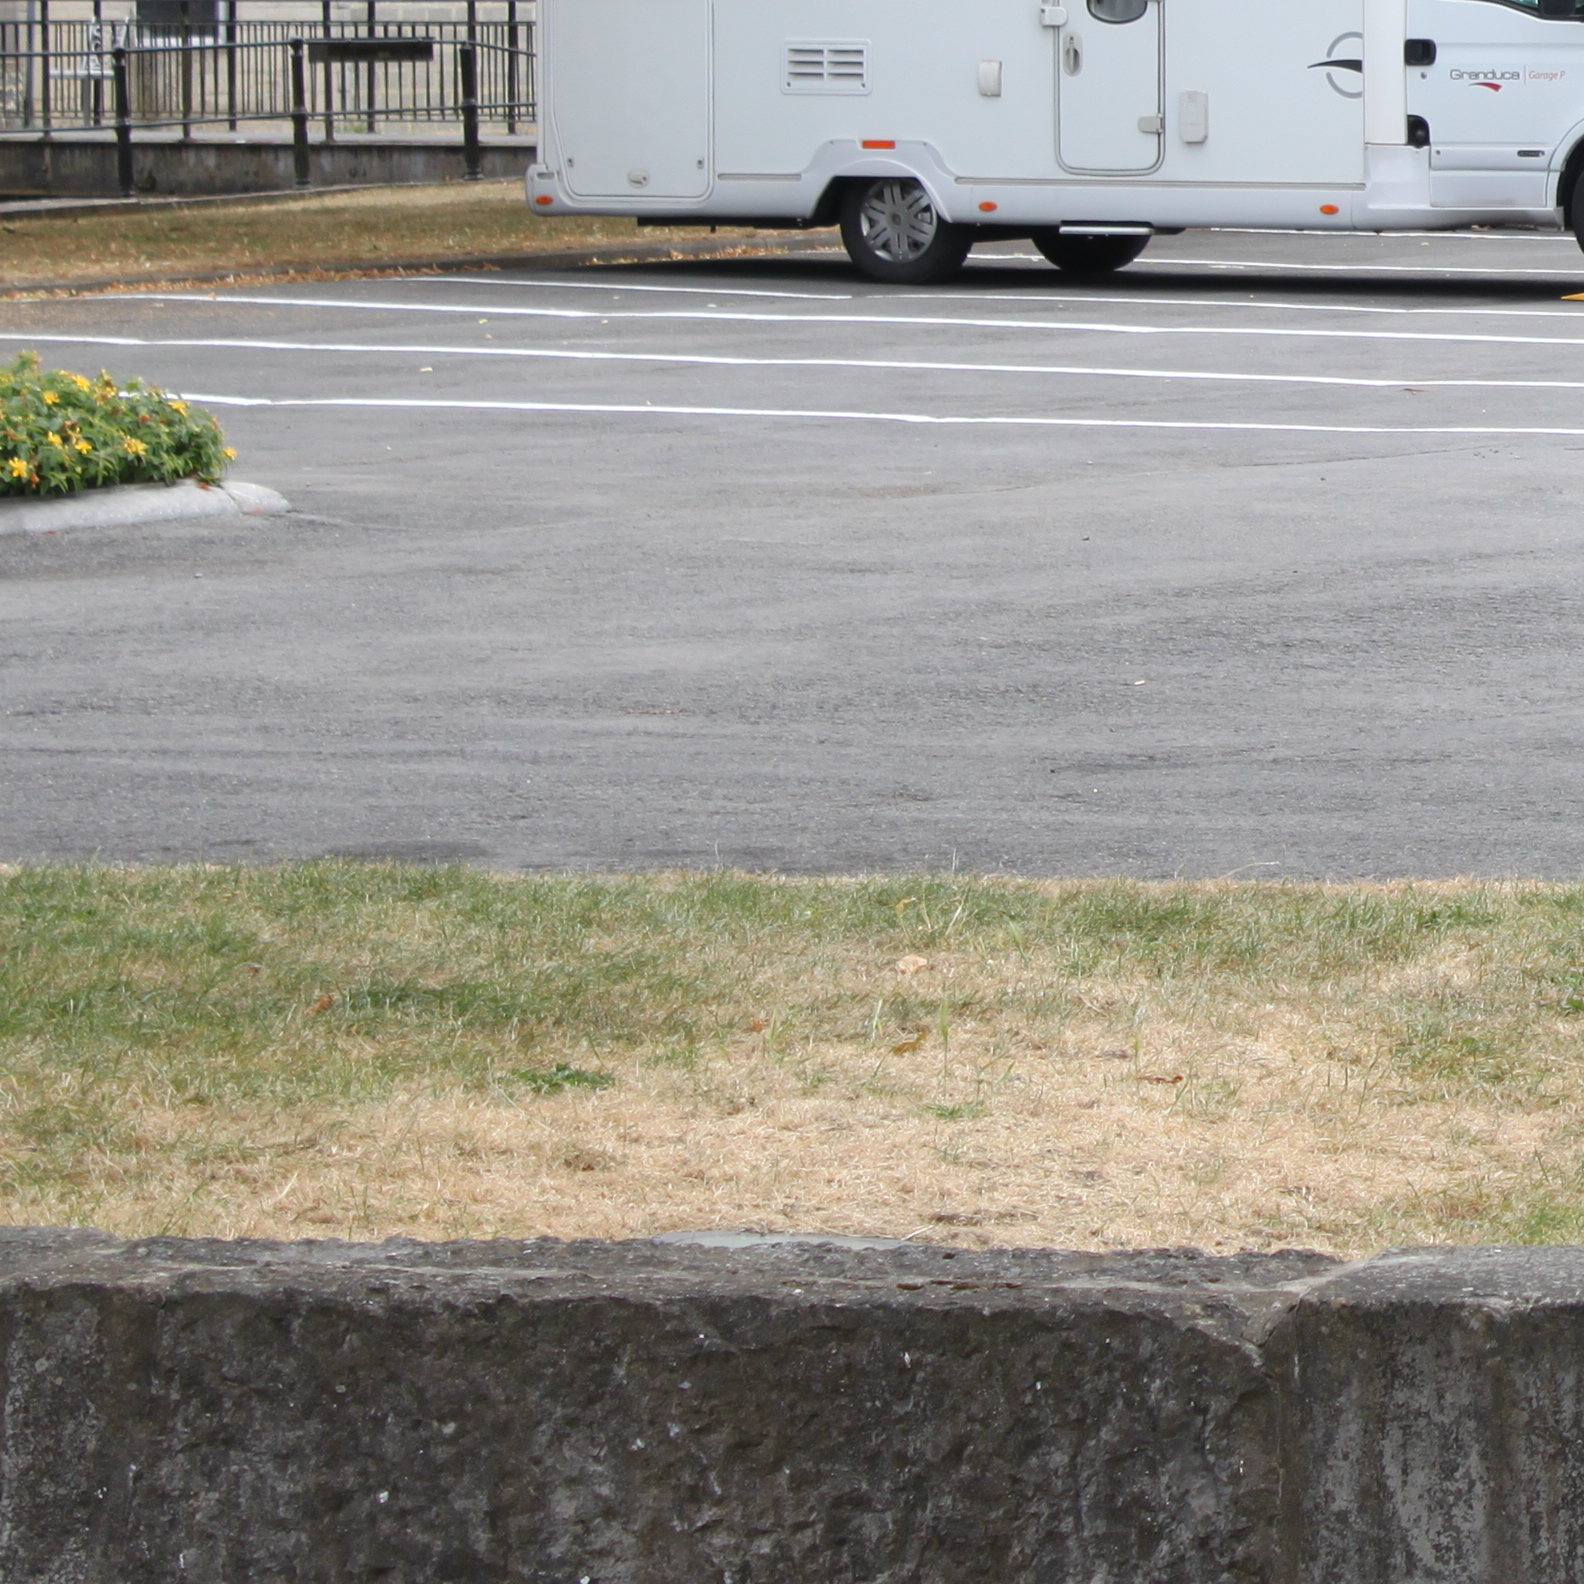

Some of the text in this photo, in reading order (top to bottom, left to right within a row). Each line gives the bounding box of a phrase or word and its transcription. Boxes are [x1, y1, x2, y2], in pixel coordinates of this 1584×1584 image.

[1449, 68, 1566, 82] Granduca Garage P
